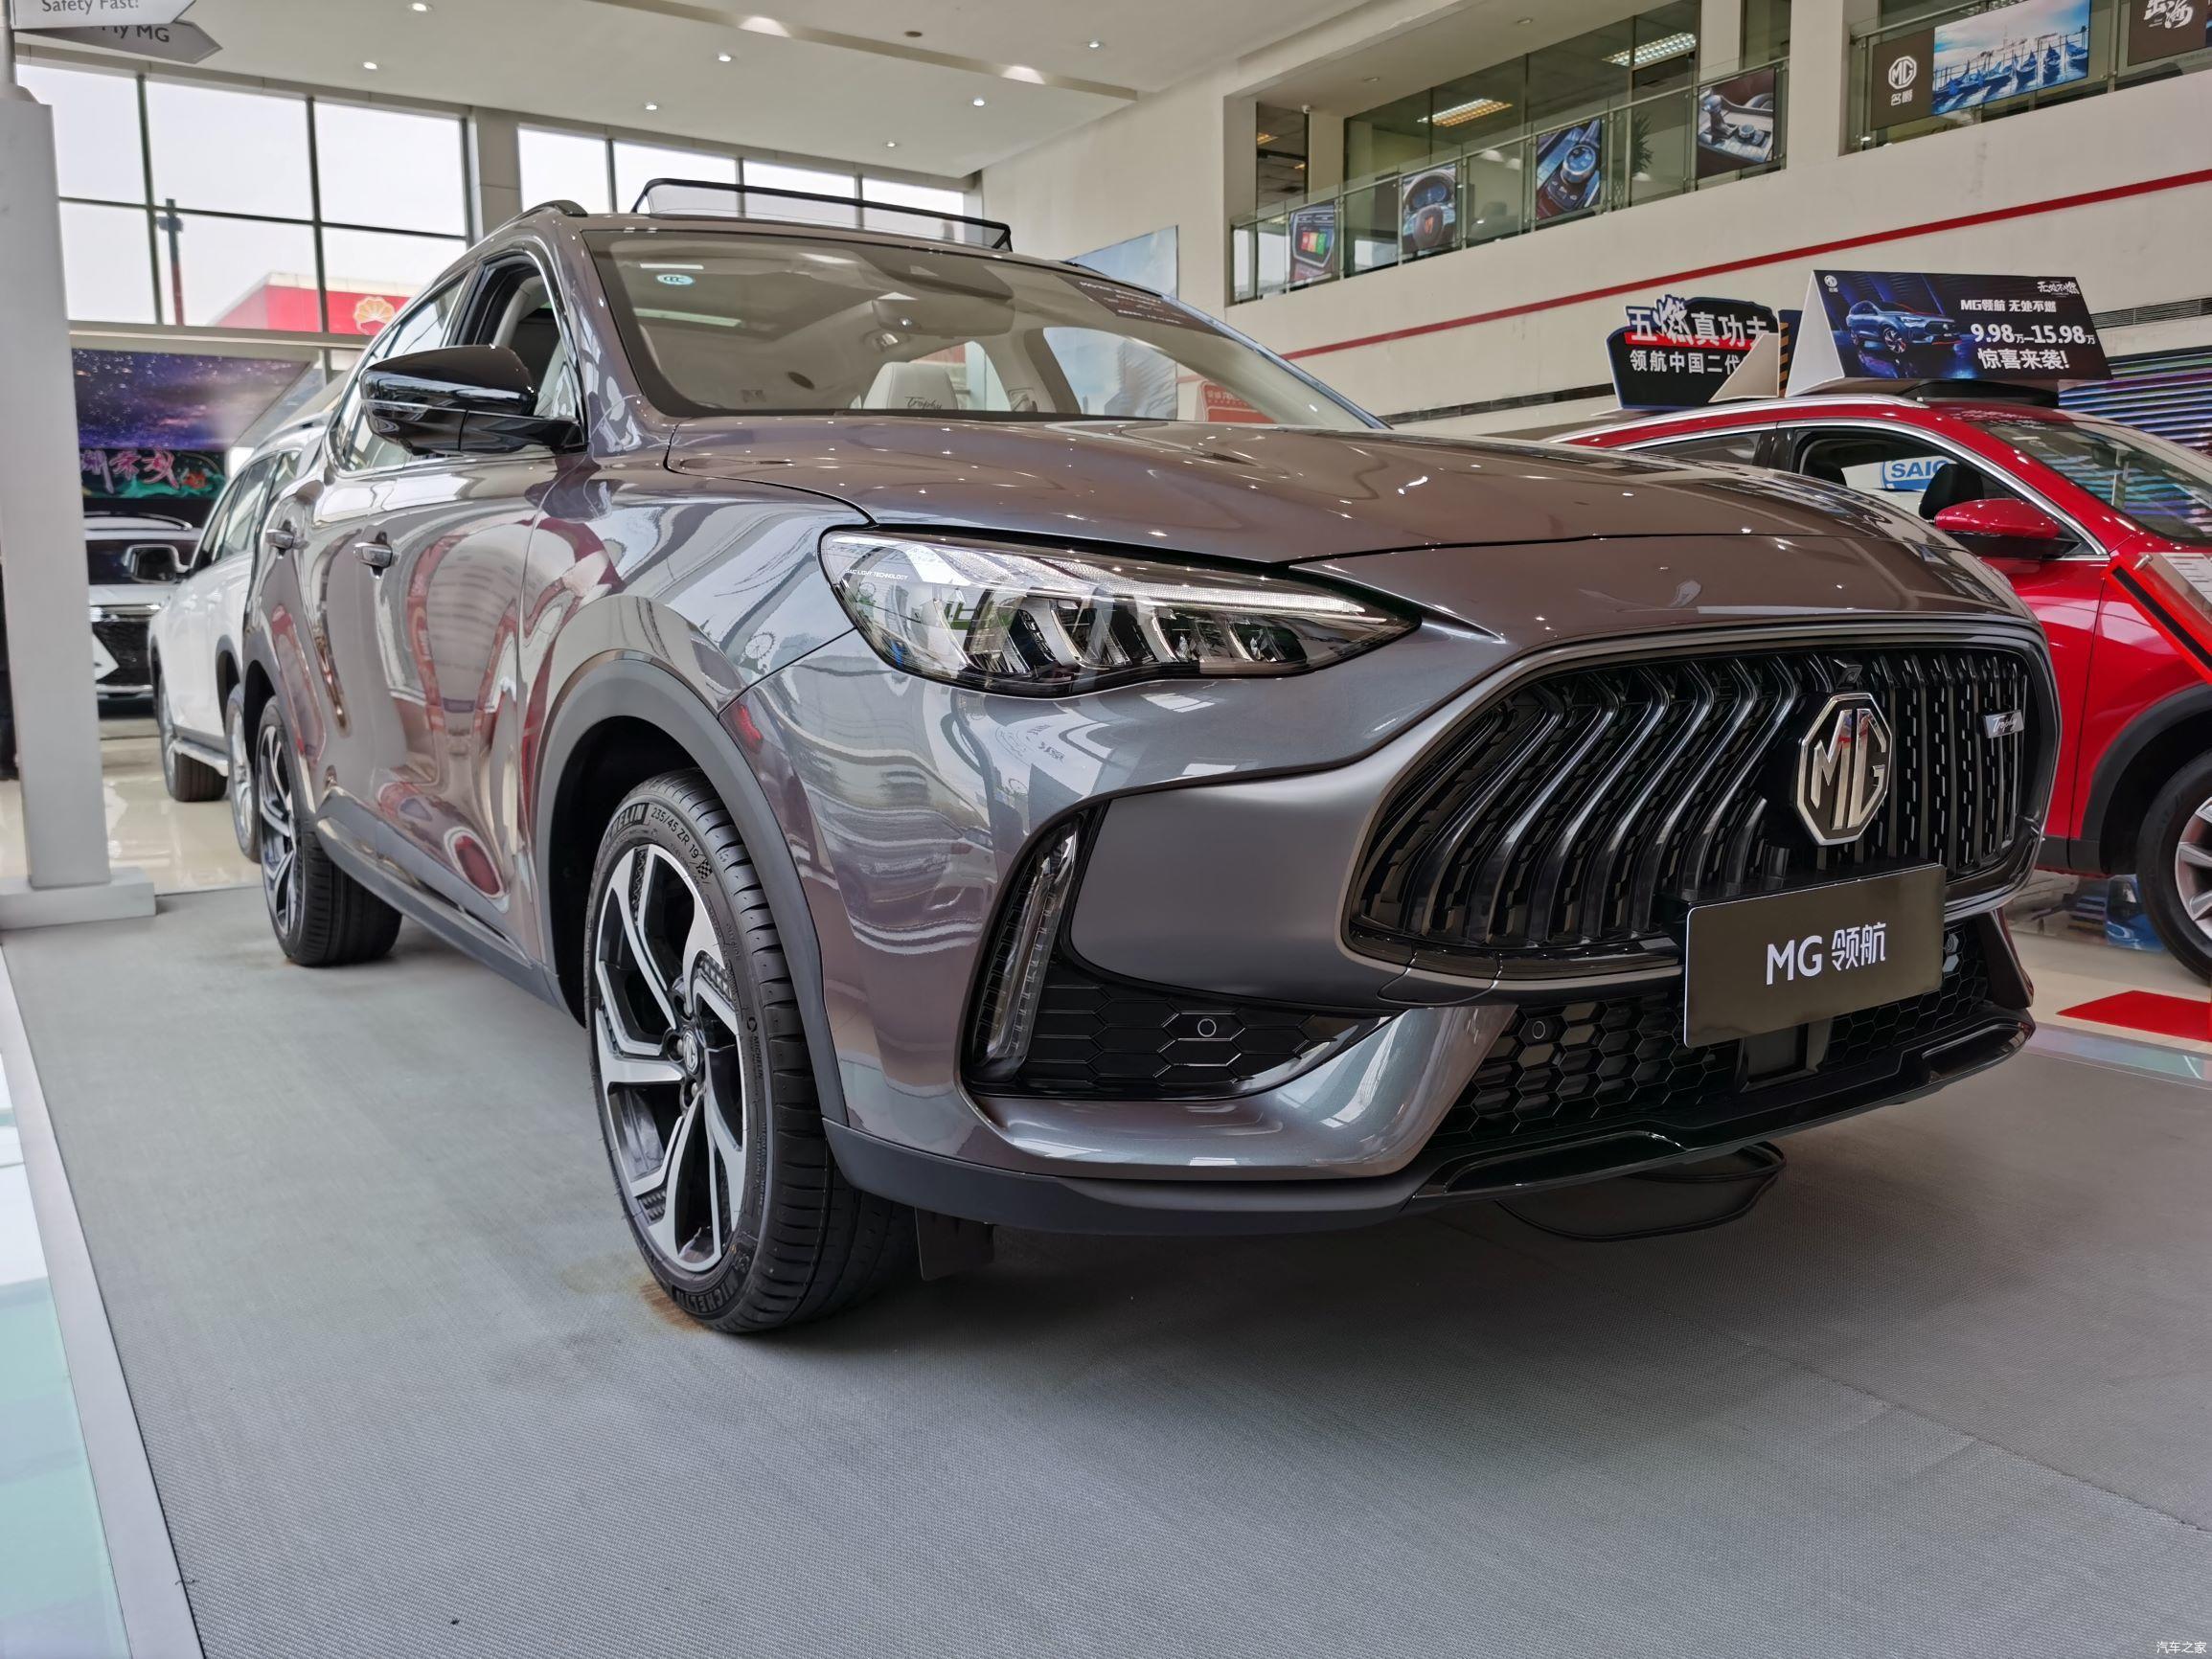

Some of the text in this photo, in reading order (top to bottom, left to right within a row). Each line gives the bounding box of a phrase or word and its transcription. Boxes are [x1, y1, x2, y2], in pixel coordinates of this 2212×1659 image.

[42, 0, 91, 15] Safety
[137, 25, 170, 42] MG
[1890, 58, 1915, 87] MG
[2009, 300, 2057, 312] 无处不燃
[1801, 699, 1889, 839] MG
[650, 807, 679, 832] 235/45
[676, 828, 691, 845] ZR
[689, 844, 699, 859] 19
[1766, 921, 1886, 985] MG 领航
[753, 1035, 764, 1080] MICHELIN
